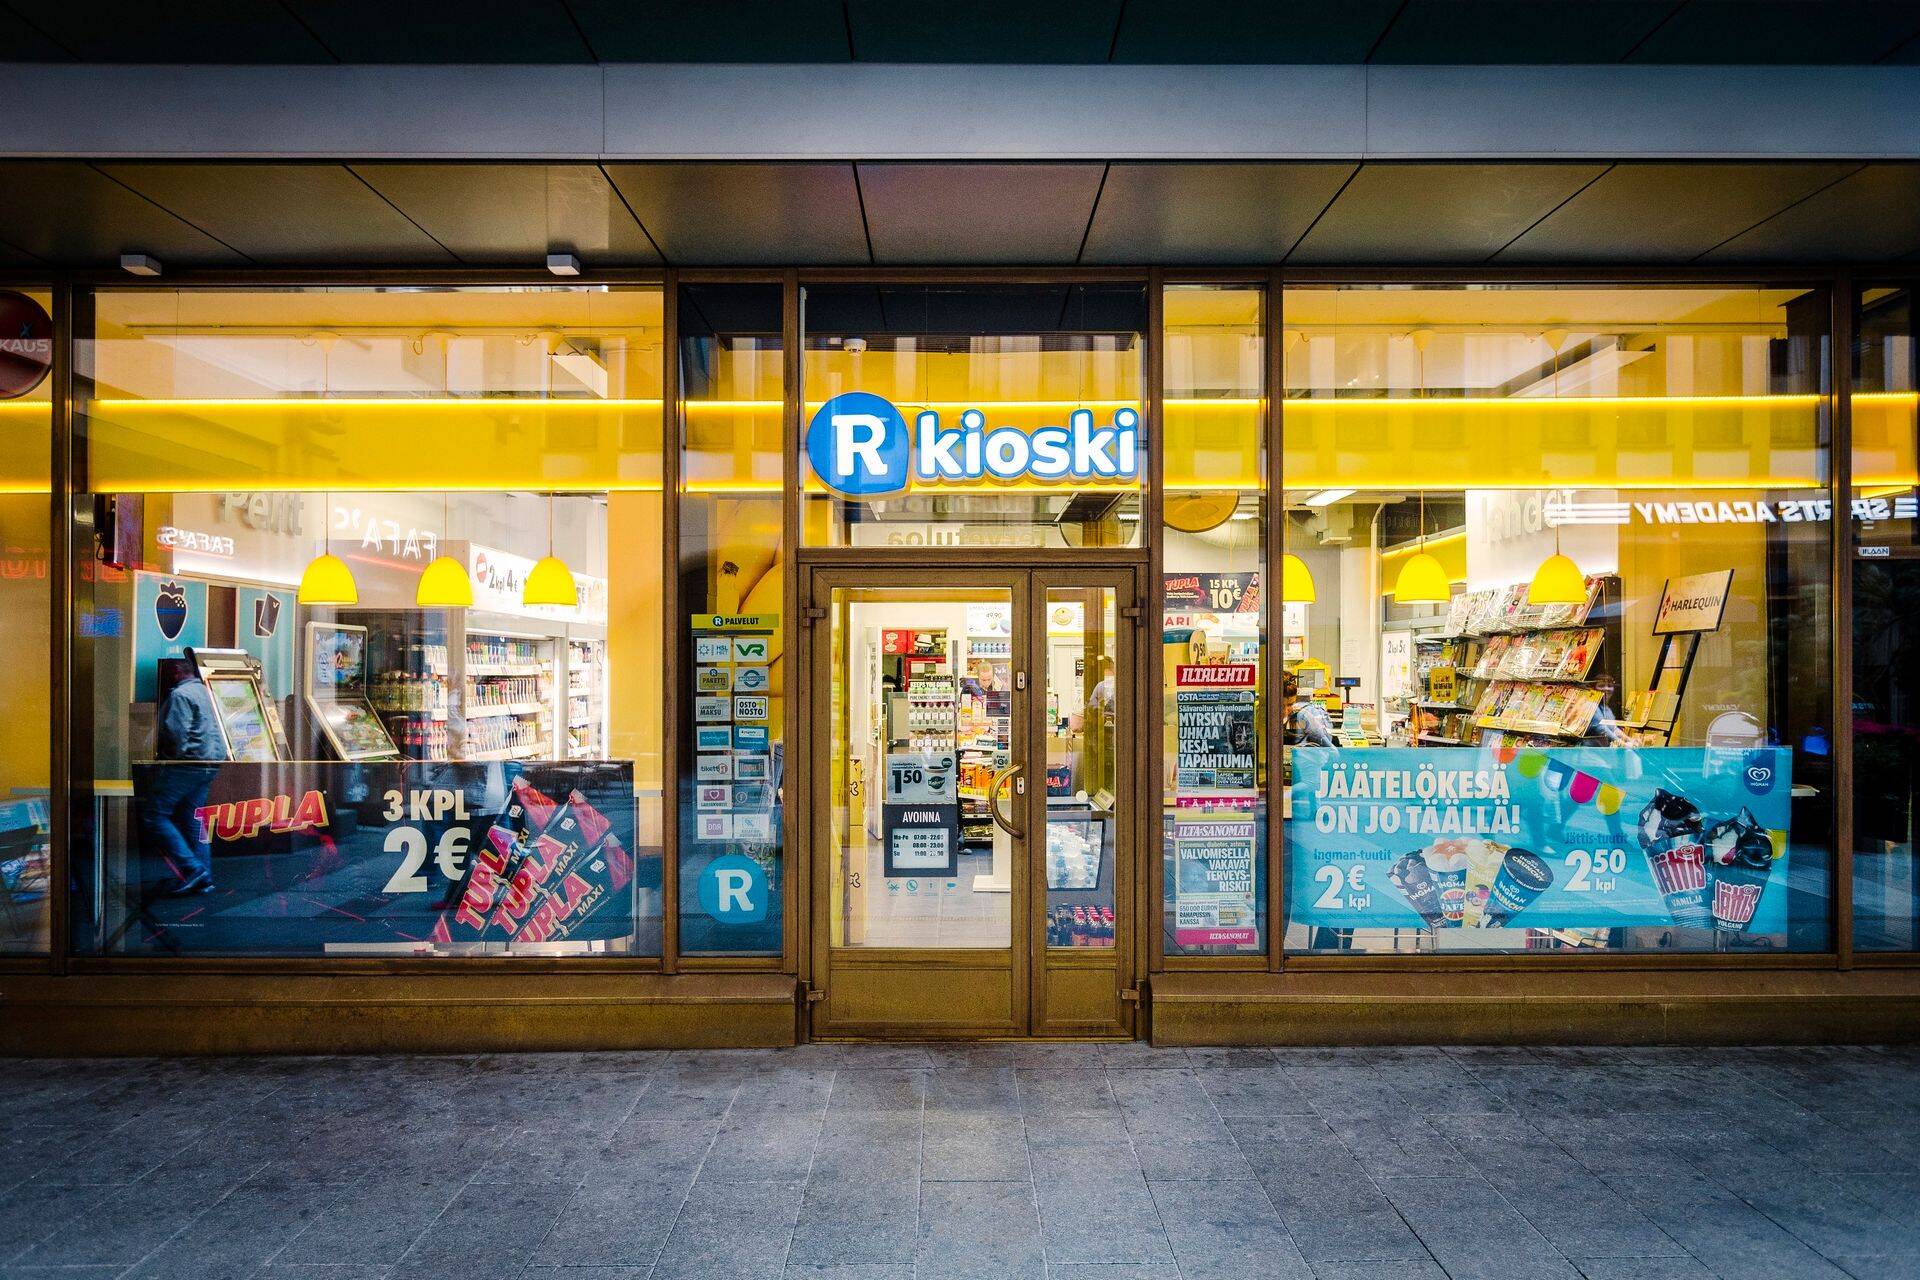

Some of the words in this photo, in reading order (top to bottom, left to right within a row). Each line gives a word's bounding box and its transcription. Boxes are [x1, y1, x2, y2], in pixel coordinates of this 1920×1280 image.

[832, 414, 888, 476] R
[917, 408, 1138, 477] kioski
[1165, 577, 1199, 591] TUPLA
[1210, 580, 1220, 588] 15
[1670, 594, 1722, 612] HARLEQUIN
[725, 617, 759, 625] PALVELUT
[736, 644, 764, 656] VR
[1181, 667, 1251, 683] ILTALEHTI
[1178, 693, 1199, 701] OSTA
[1179, 712, 1226, 726] MYRSKY
[1179, 727, 1220, 739] UHKAA
[1179, 739, 1215, 753] KESÄ-
[1179, 754, 1253, 768] TAPAHTUMIA
[1315, 763, 1511, 799] JÄÄTELÖKESÄ
[1181, 798, 1251, 807] TÄNÄÄN
[194, 789, 329, 844] TUPLA
[383, 790, 403, 821] 3
[410, 789, 470, 821] KPL
[902, 811, 941, 823] AVOINNA
[1315, 805, 1358, 834] ON
[1364, 805, 1400, 834] JO
[1406, 799, 1520, 834] TÄÄLLÄ!
[382, 826, 470, 893] 2€
[554, 841, 579, 876] MAXI
[1180, 847, 1250, 859] VALVOMISELLA
[1208, 860, 1251, 870] VAKAVAT
[455, 825, 518, 931] TUPLA
[1206, 870, 1250, 880] TERVEYS-
[492, 834, 568, 935] TUPLA
[715, 870, 754, 911] R
[1219, 881, 1250, 891] RISKIT
[1313, 864, 1366, 909] 2€
[1438, 881, 1465, 890] INGMA
[1596, 878, 1616, 893] kpl
[577, 884, 605, 916] MAXI
[1410, 885, 1435, 901] INGMA
[1499, 882, 1526, 904] INGMAN
[518, 871, 594, 942] UPLA
[1348, 893, 1371, 912] kpl
